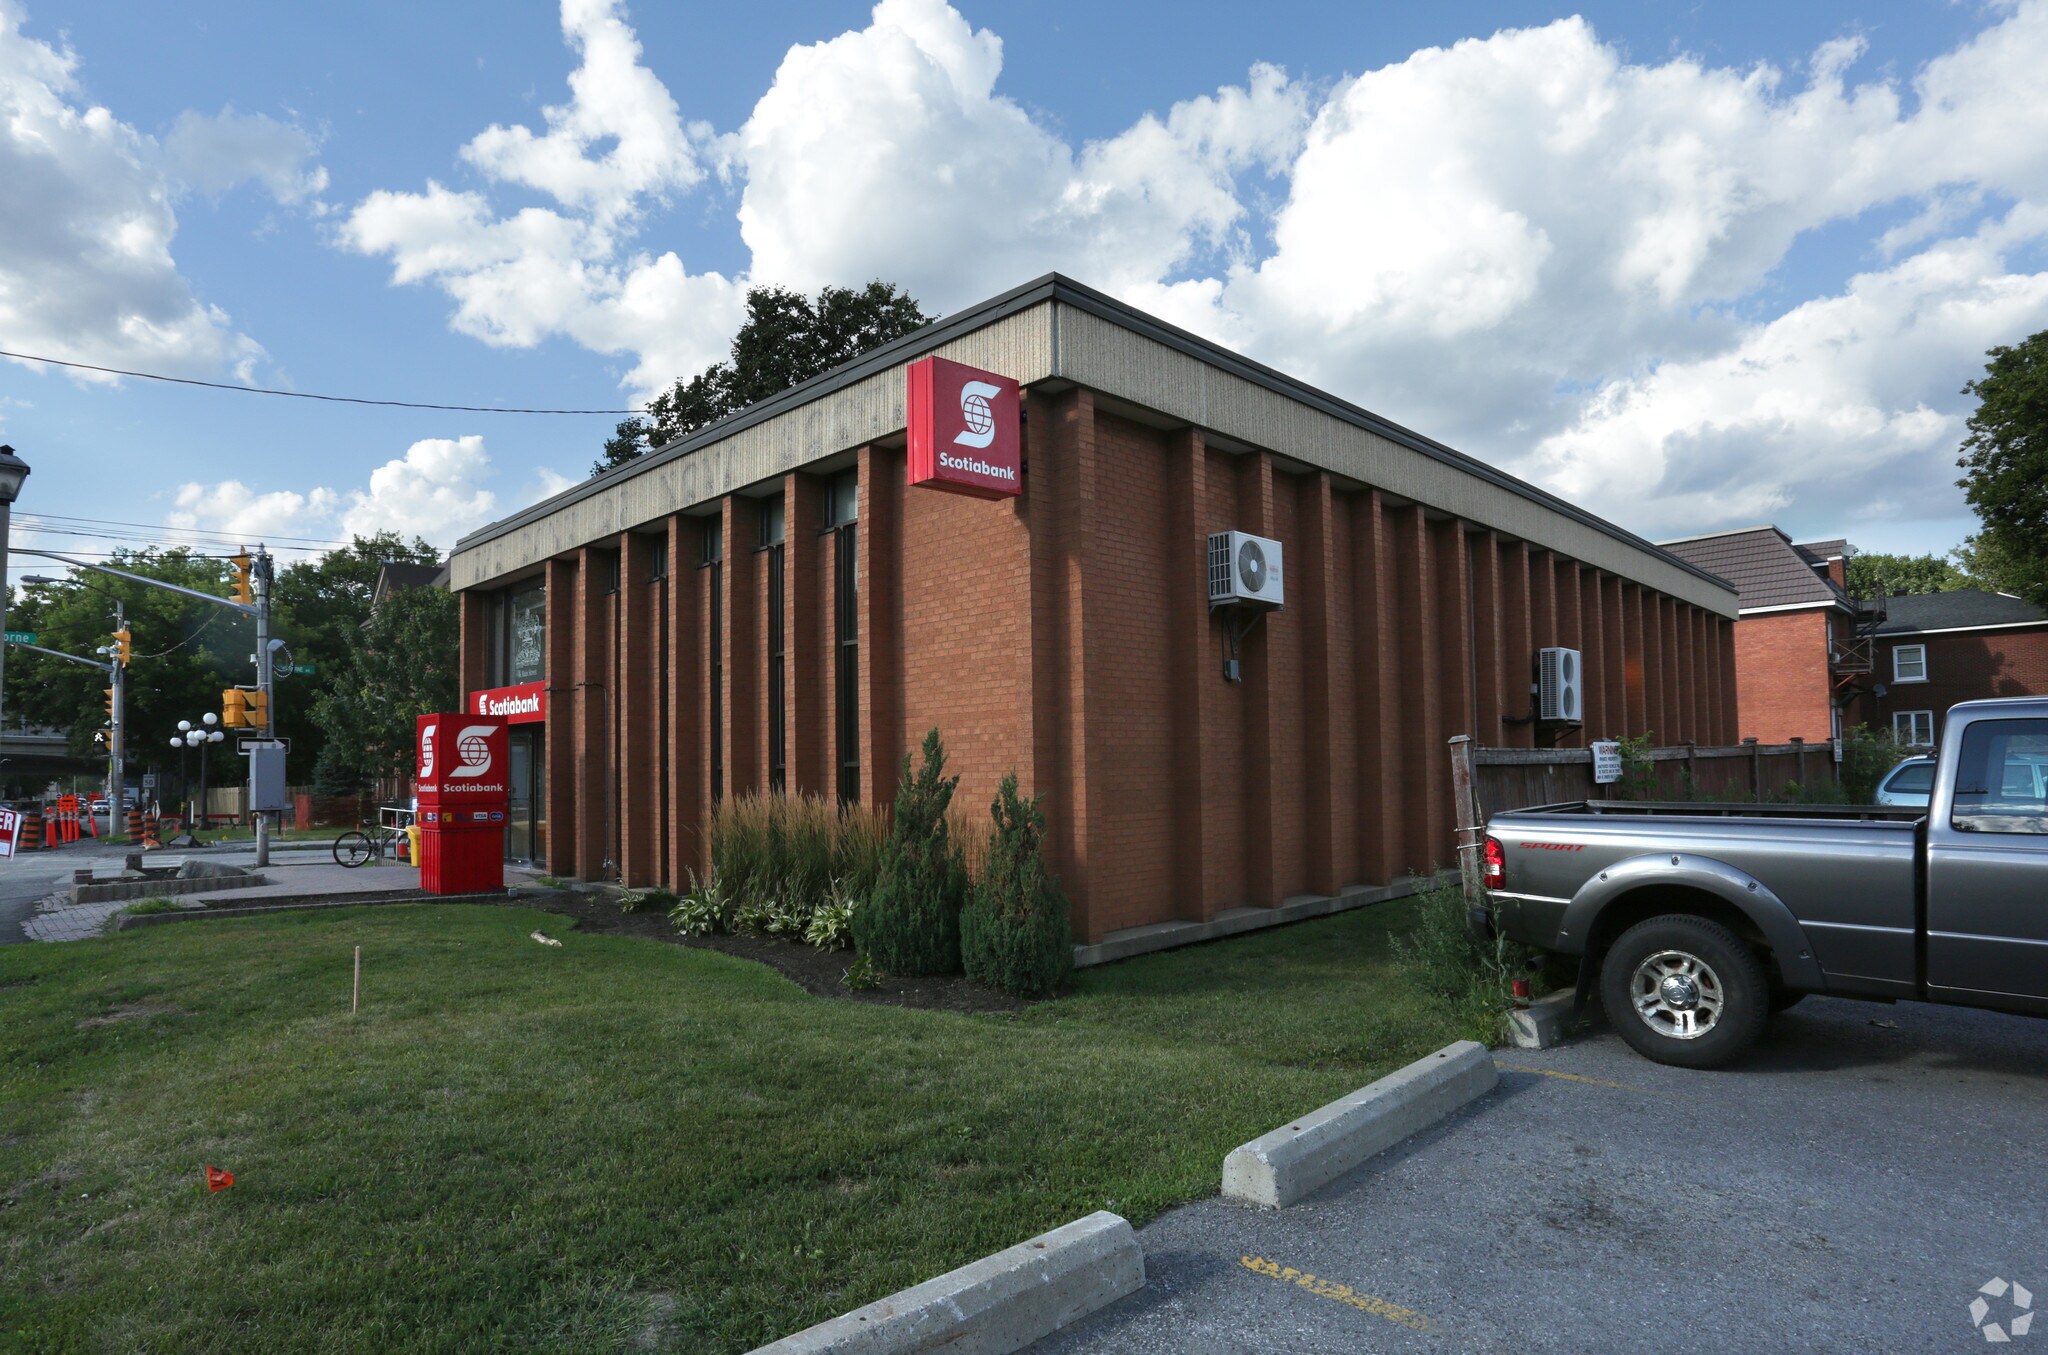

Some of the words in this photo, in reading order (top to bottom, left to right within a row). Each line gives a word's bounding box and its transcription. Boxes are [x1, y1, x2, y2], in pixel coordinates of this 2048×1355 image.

[940, 452, 1014, 480] Scotiabank
[489, 693, 540, 716] Scotiabank
[418, 783, 438, 792] Scotiabank
[443, 783, 503, 792] Scotiabank
[1519, 841, 1586, 851] SPORT
